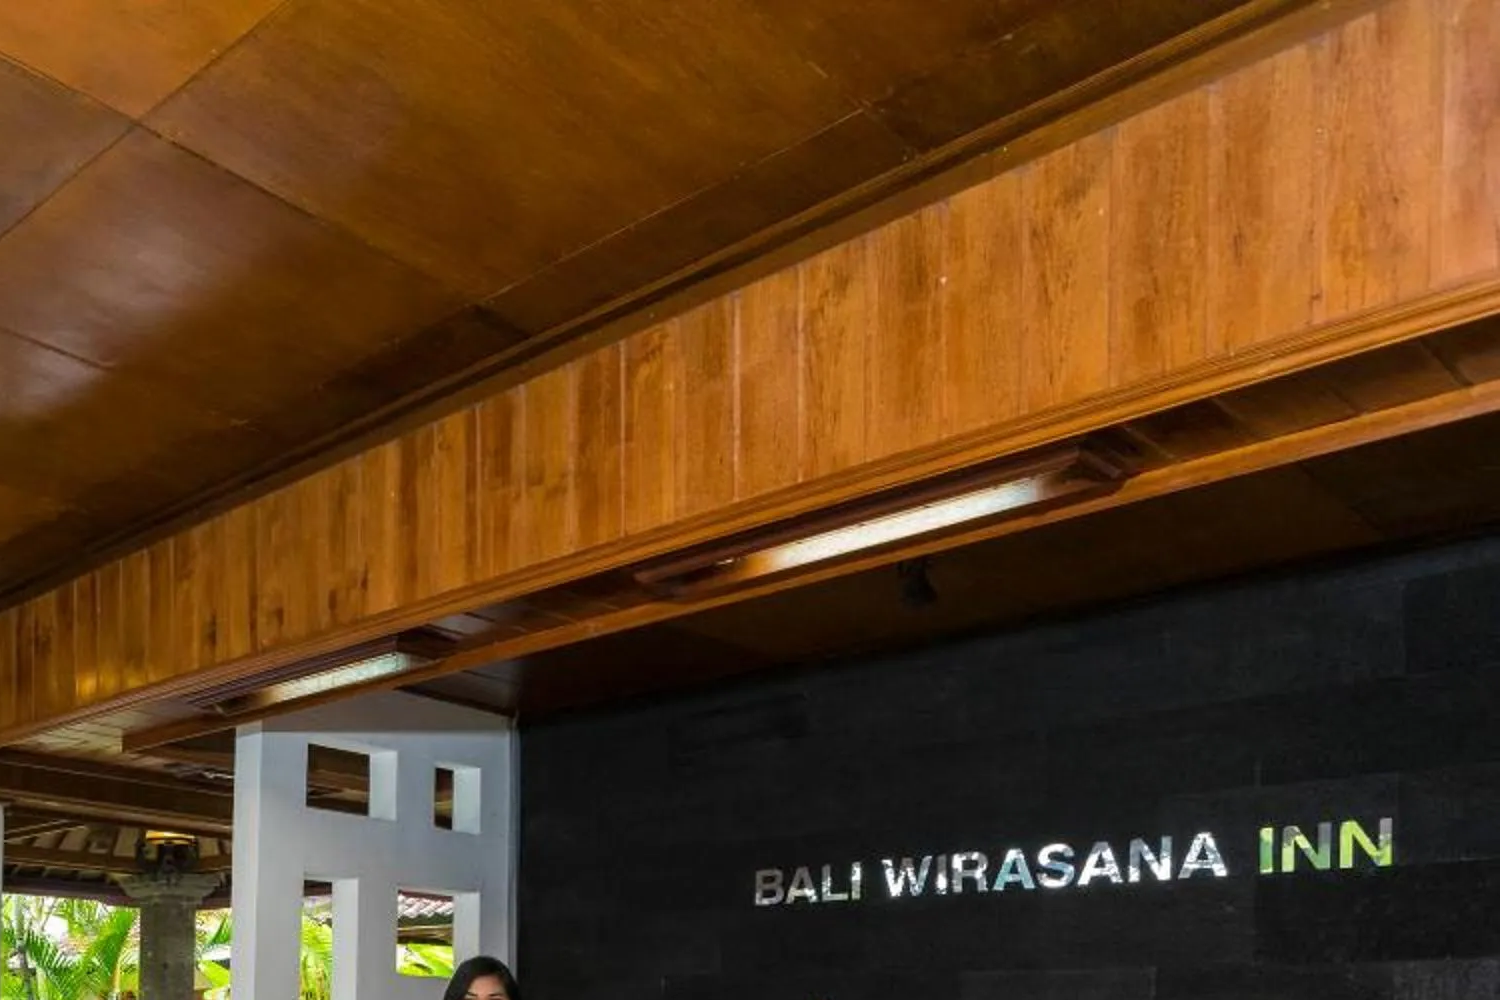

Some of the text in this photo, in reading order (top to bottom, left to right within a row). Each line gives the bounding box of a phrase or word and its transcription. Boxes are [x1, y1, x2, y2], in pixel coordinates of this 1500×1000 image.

[755, 817, 1392, 906] BALI WIRASANA INN
